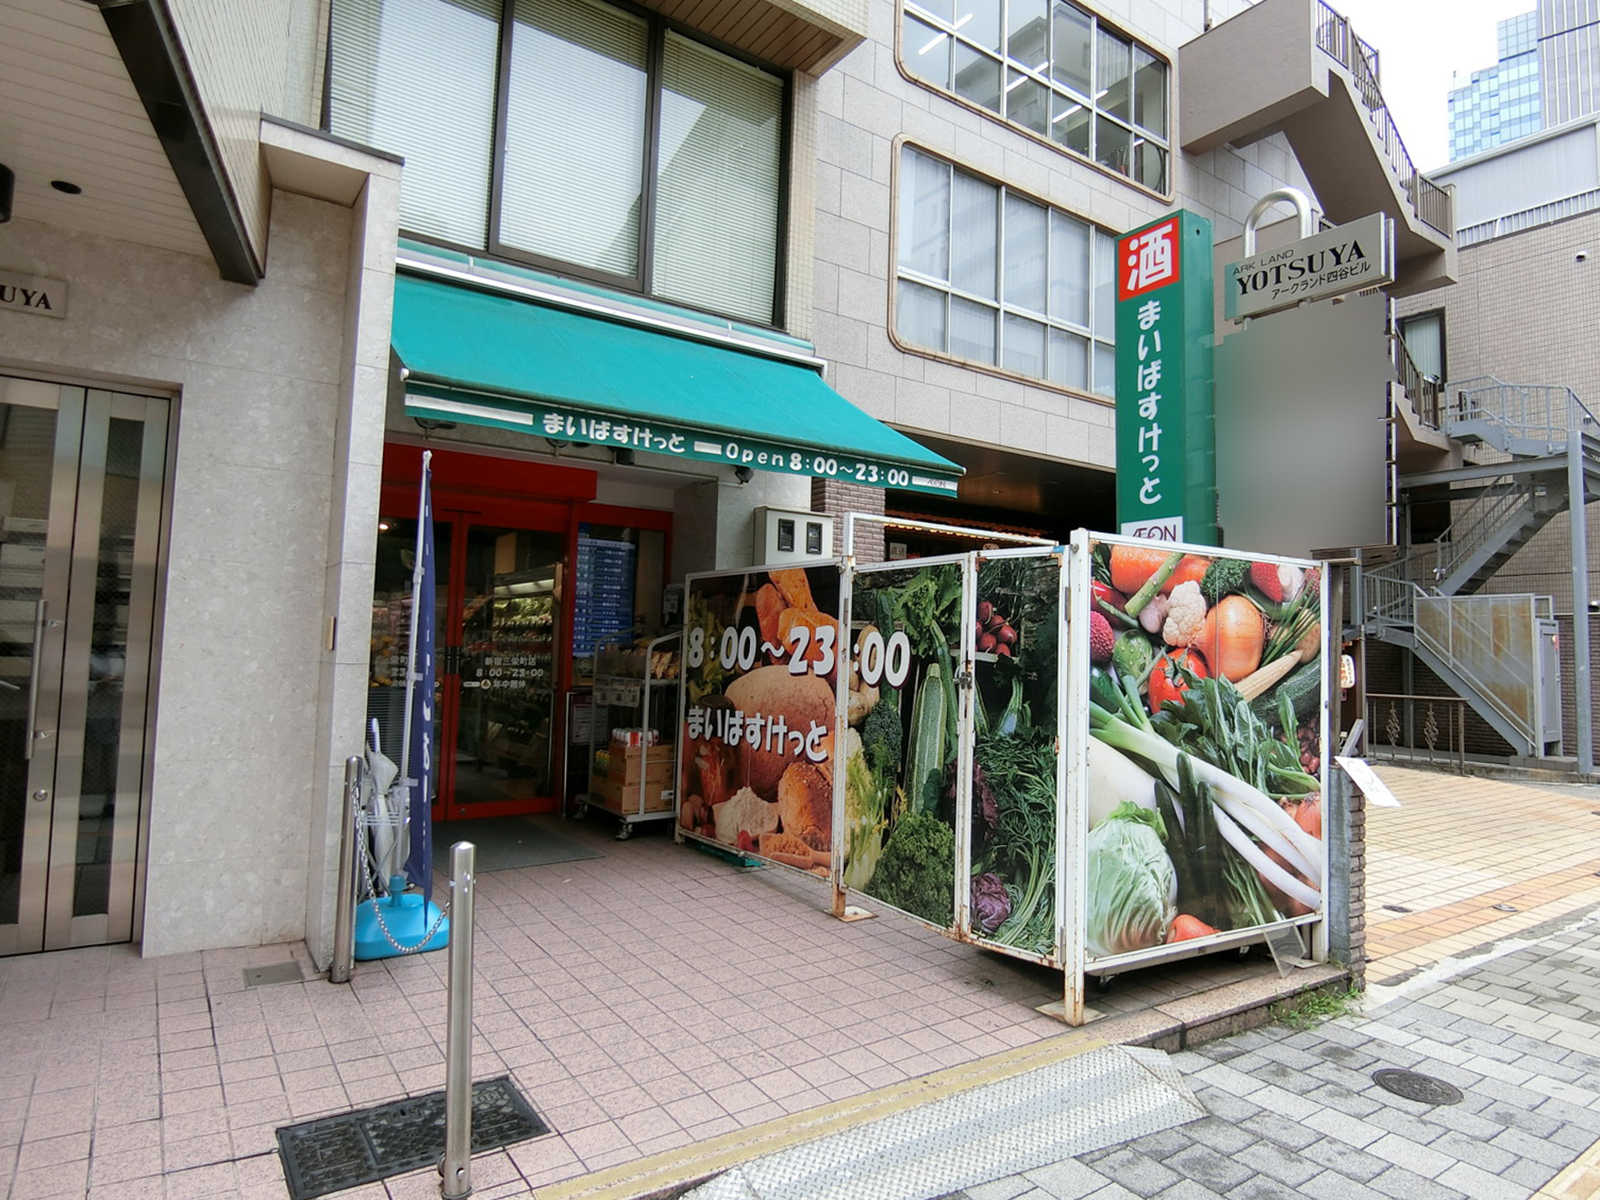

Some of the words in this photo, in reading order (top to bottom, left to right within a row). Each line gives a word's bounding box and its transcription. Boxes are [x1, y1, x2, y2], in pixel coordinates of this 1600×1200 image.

[1127, 223, 1173, 291] 酒
[1232, 261, 1256, 276] ARK
[1260, 249, 1295, 266] LAND
[1236, 240, 1366, 295] YOTSUYA
[1271, 261, 1371, 300] アークランド四谷ビル
[1137, 300, 1162, 505] まいばすけっと
[542, 412, 686, 454] まいばすけっと
[725, 442, 784, 468] Open
[688, 704, 829, 763] まいばすけっと
